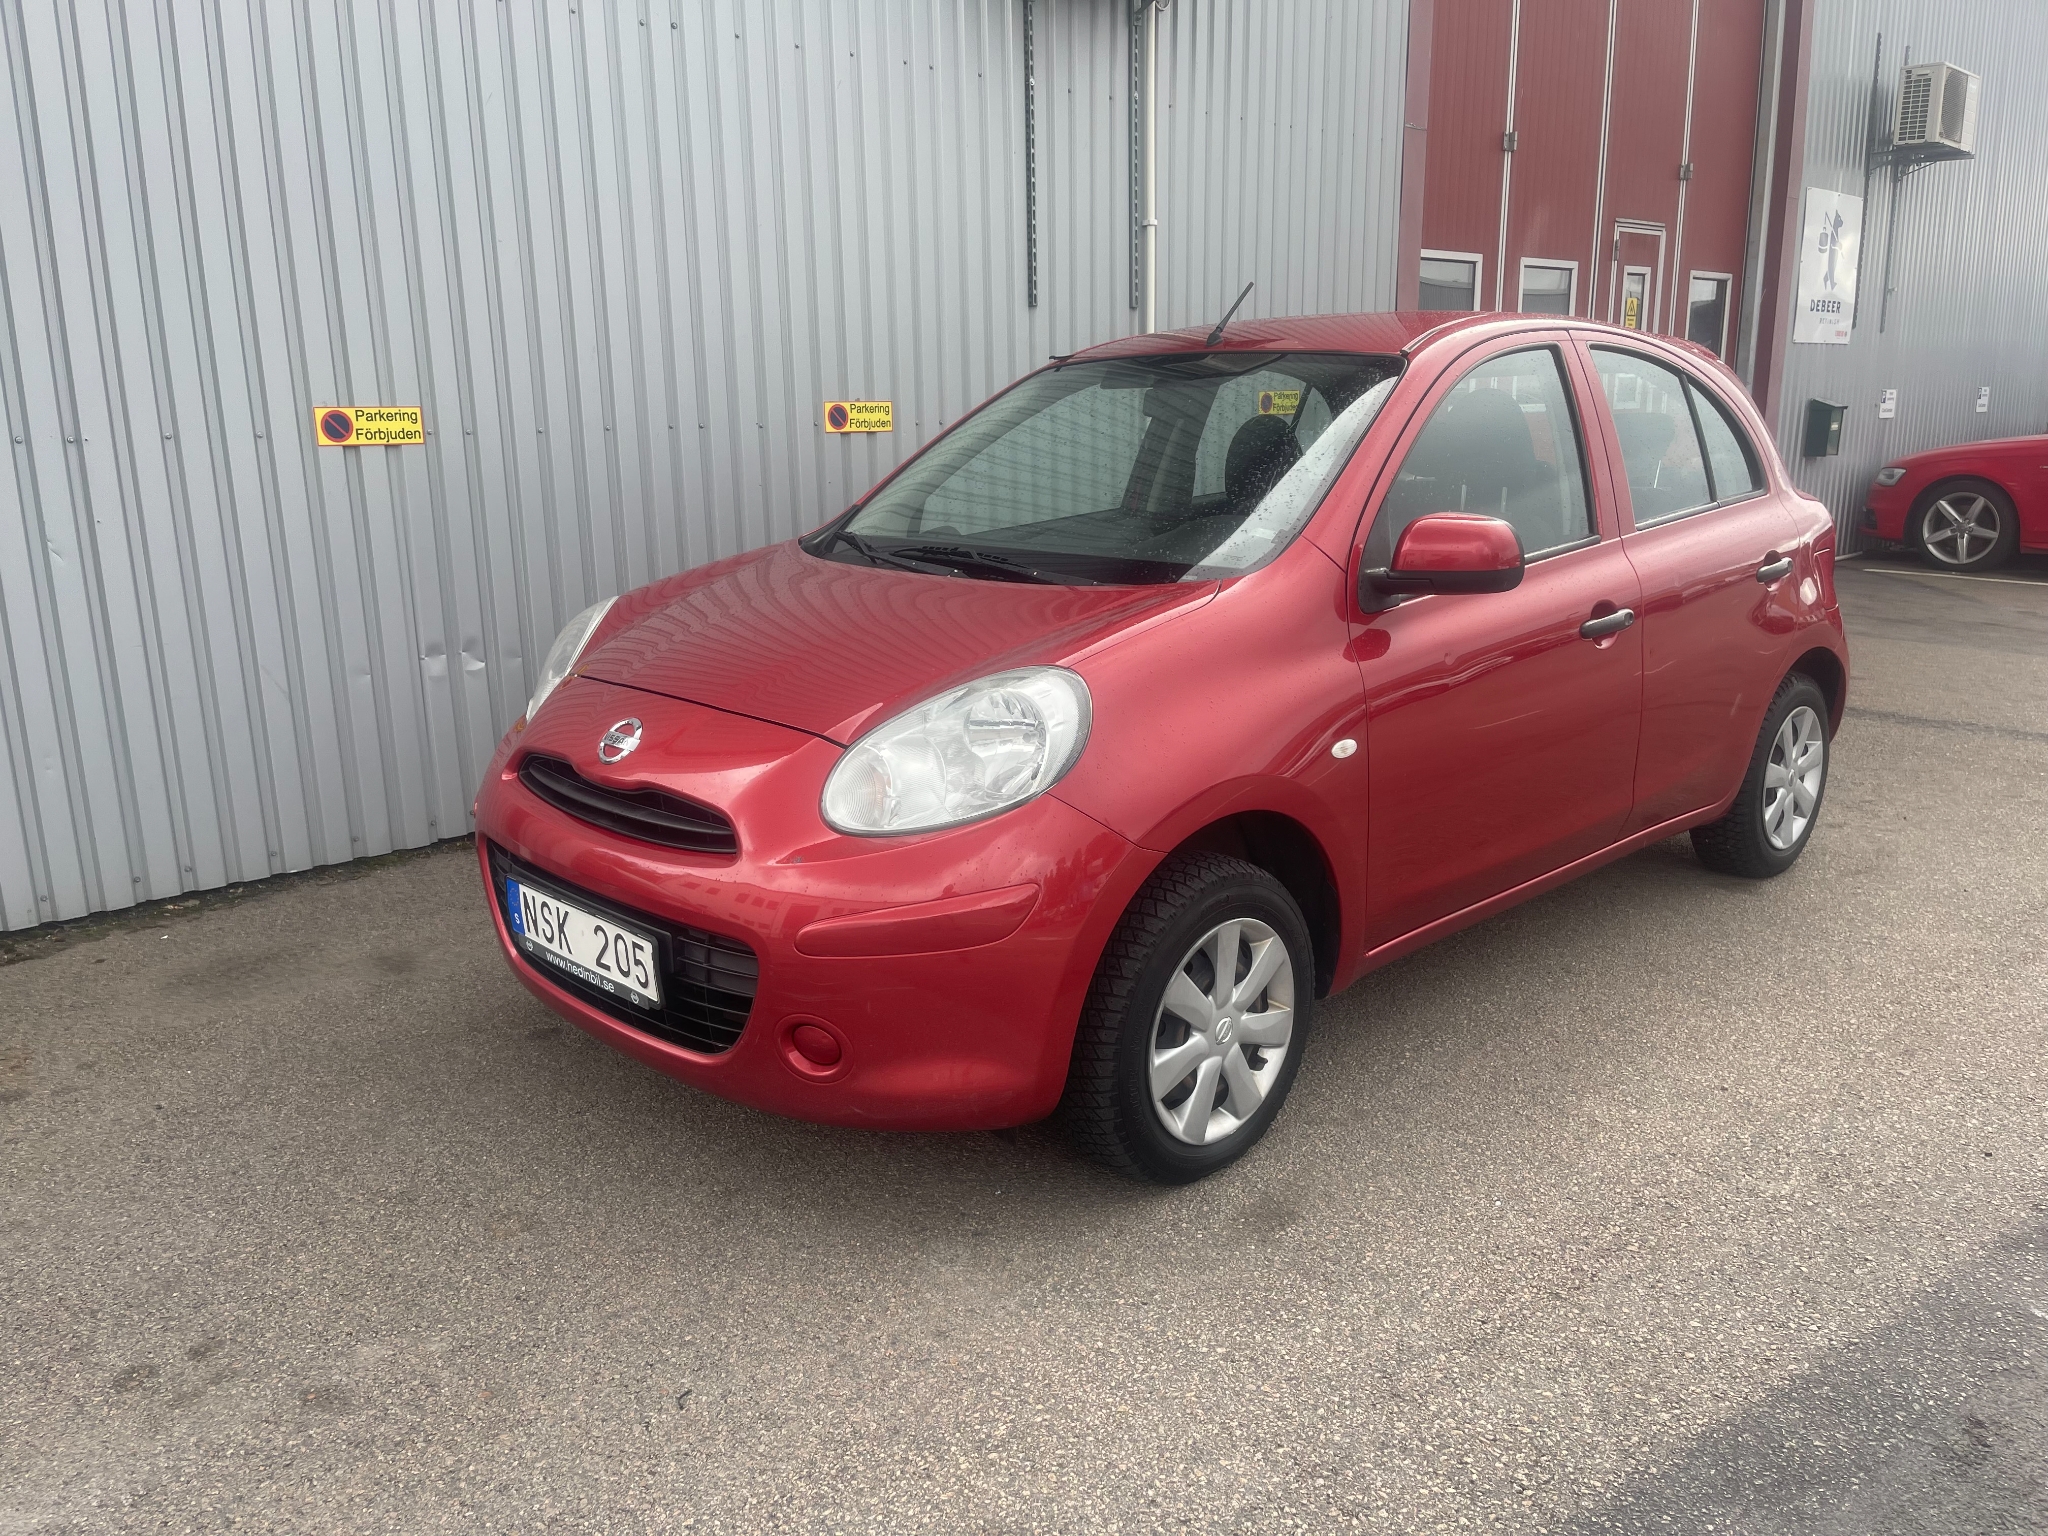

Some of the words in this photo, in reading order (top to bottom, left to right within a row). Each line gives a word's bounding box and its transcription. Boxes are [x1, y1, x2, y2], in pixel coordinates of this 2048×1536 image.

[1810, 299, 1841, 313] DEBEER
[1273, 392, 1299, 401] Parkering
[849, 403, 890, 415] Parkering
[355, 409, 418, 424] Parkering
[849, 418, 892, 430] Förbjuden
[355, 428, 422, 443] Förbjuden
[514, 913, 521, 924] S
[522, 891, 573, 955] NSK
[594, 924, 649, 989] 205
[545, 951, 615, 993] www.hedinbil.se
